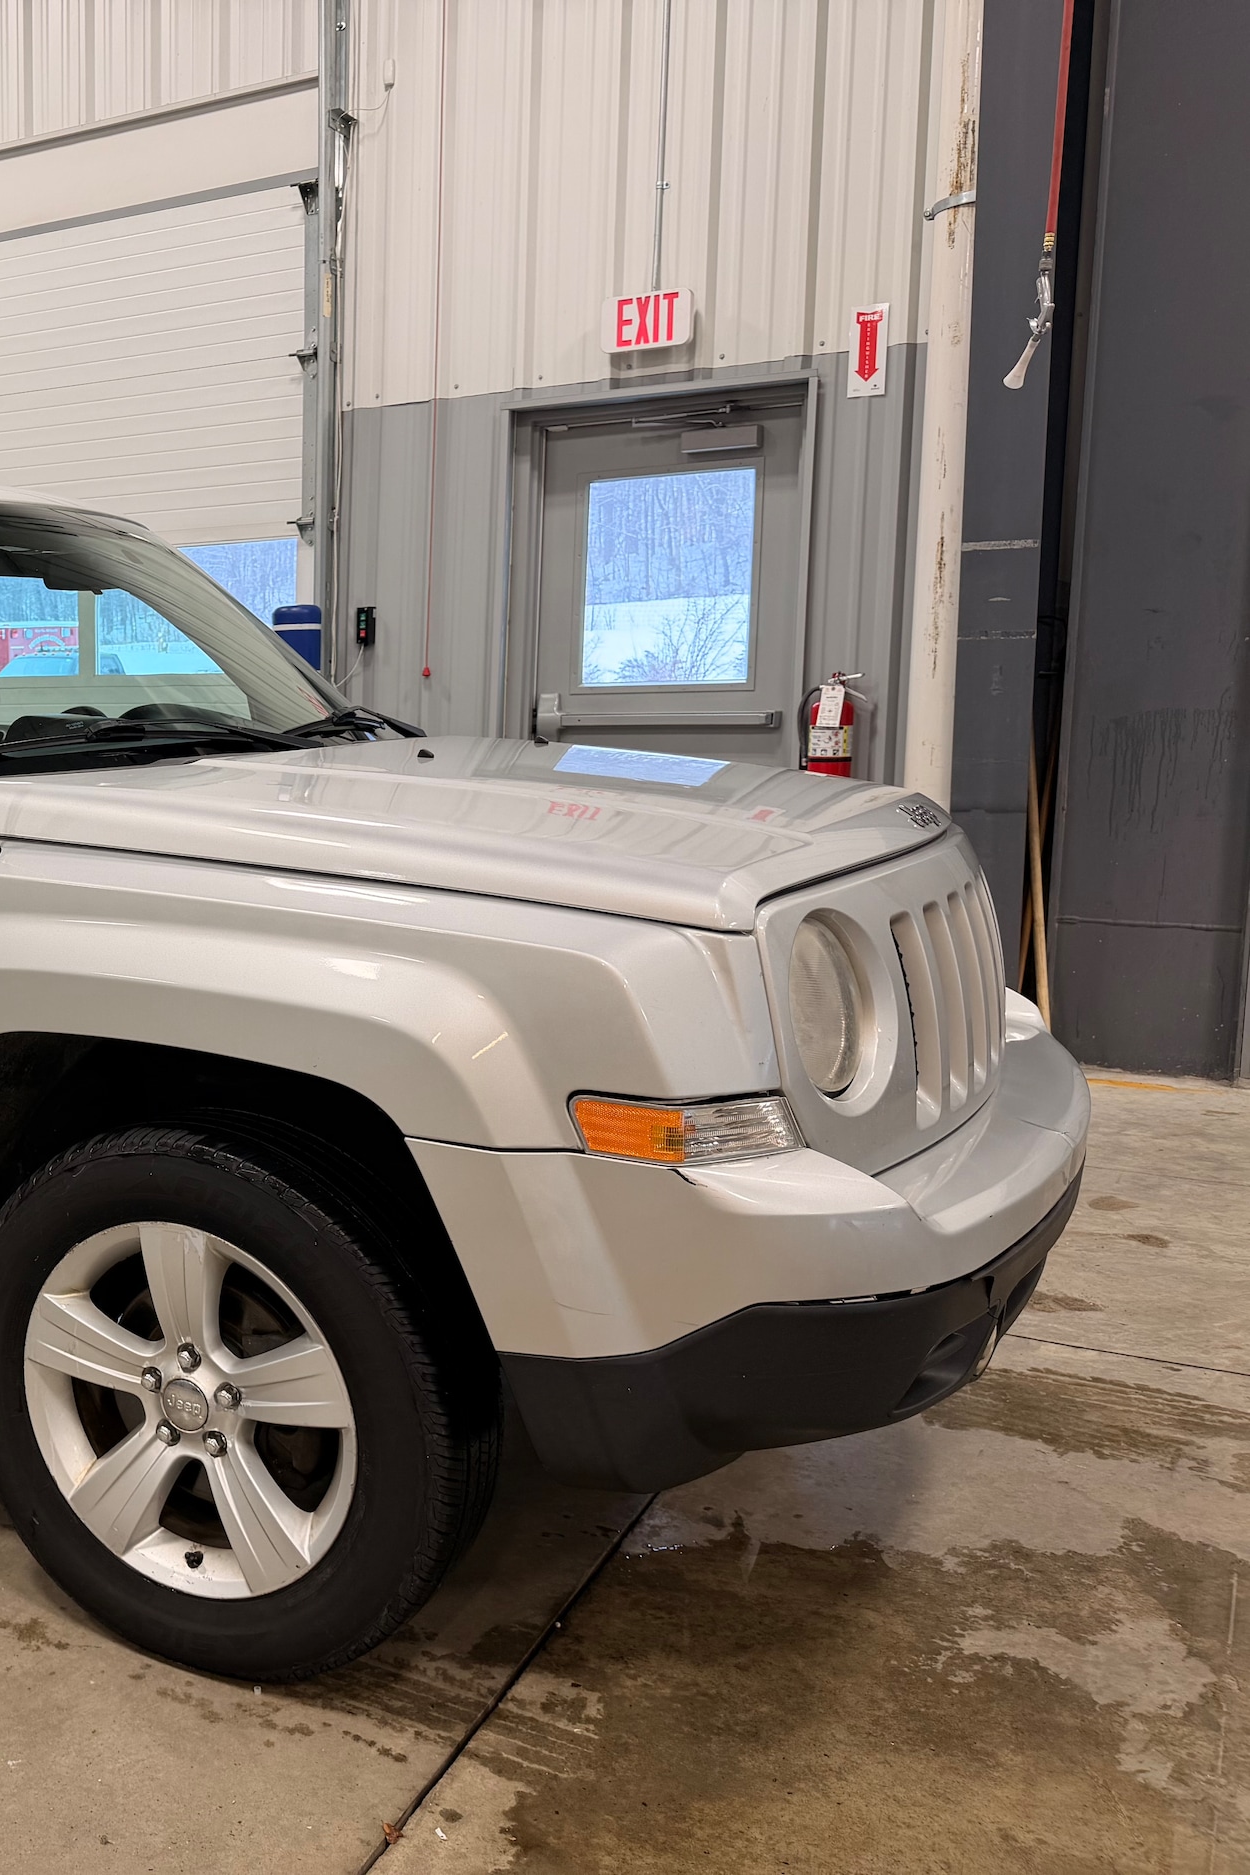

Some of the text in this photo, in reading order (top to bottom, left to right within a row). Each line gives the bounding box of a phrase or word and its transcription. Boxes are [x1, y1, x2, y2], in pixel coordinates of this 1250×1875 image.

[616, 291, 679, 348] EXIT
[858, 313, 881, 322] FIRE
[167, 1393, 202, 1416] Jeep
